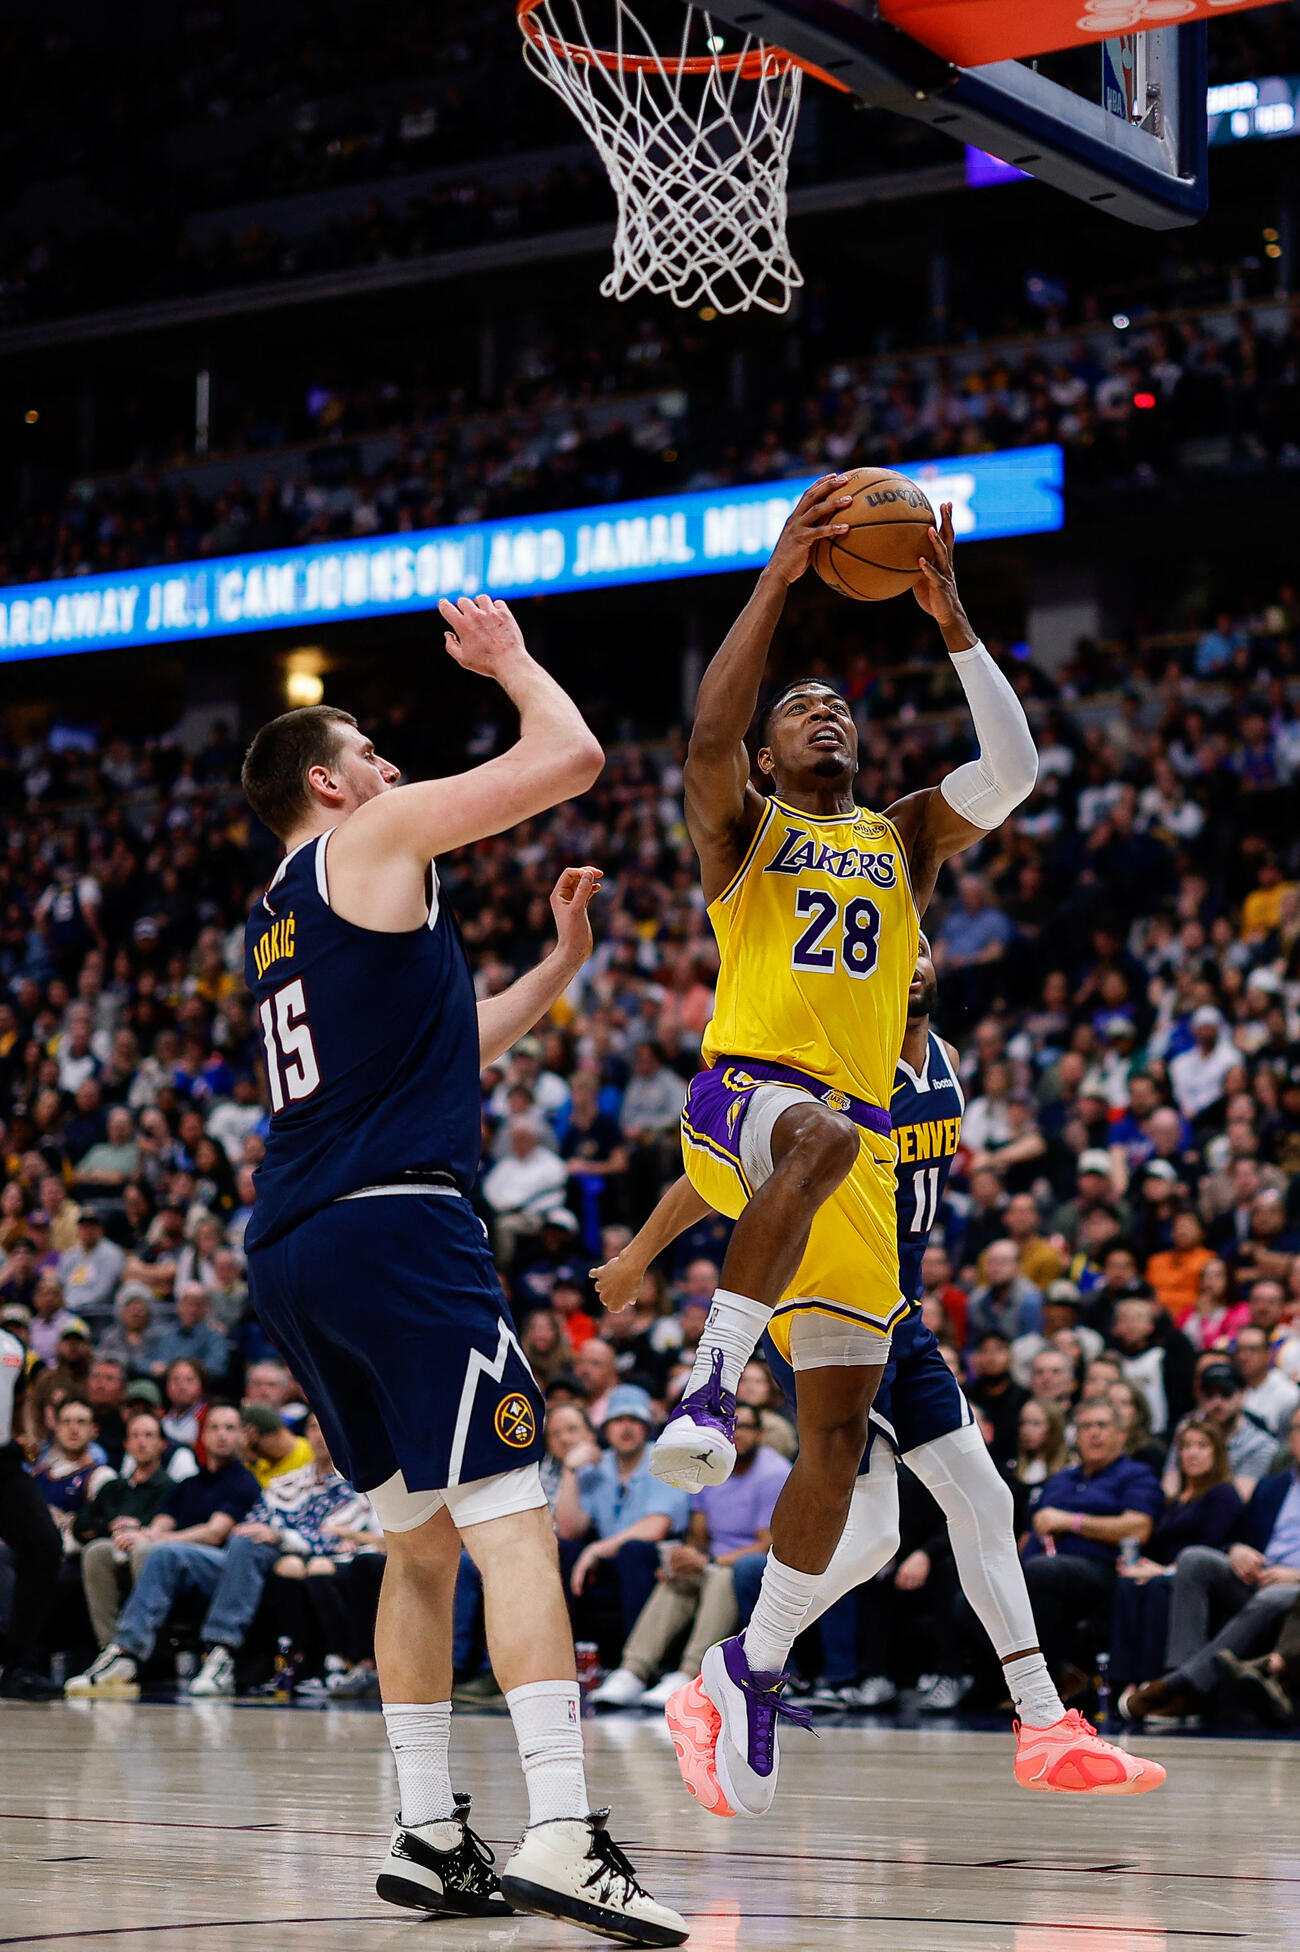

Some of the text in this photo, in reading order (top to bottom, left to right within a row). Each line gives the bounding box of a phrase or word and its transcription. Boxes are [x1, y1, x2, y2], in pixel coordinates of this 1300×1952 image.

[218, 562, 297, 622] CAM
[486, 527, 565, 588] AND
[572, 511, 695, 577] JAMAL
[763, 825, 897, 890] LAKERS
[253, 911, 296, 981] JOKIĆ
[790, 887, 882, 980] 28
[259, 976, 321, 1115] 15
[890, 1116, 962, 1164] ENVER
[910, 1166, 939, 1233] 11
